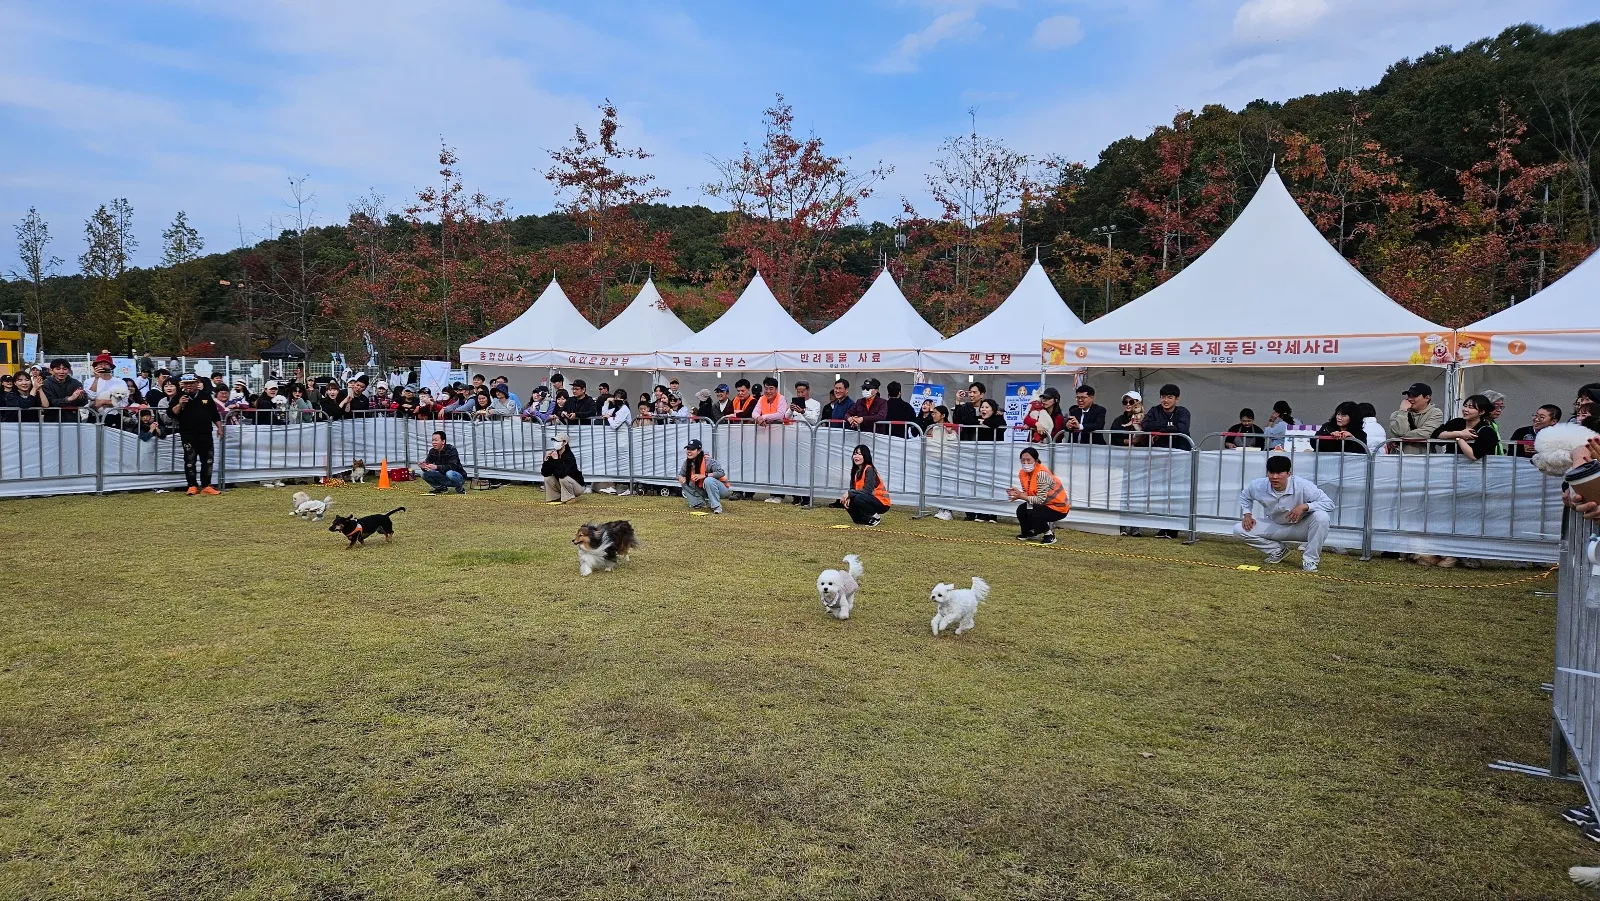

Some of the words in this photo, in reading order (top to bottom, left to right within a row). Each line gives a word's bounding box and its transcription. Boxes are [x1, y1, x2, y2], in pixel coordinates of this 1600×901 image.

[1118, 342, 1181, 356] 반려동물
[1189, 339, 1339, 355] 수제푸딩·악세사리
[672, 356, 746, 367] 구급·응급부스
[800, 352, 848, 363] 반려동물
[857, 352, 881, 363] 사료
